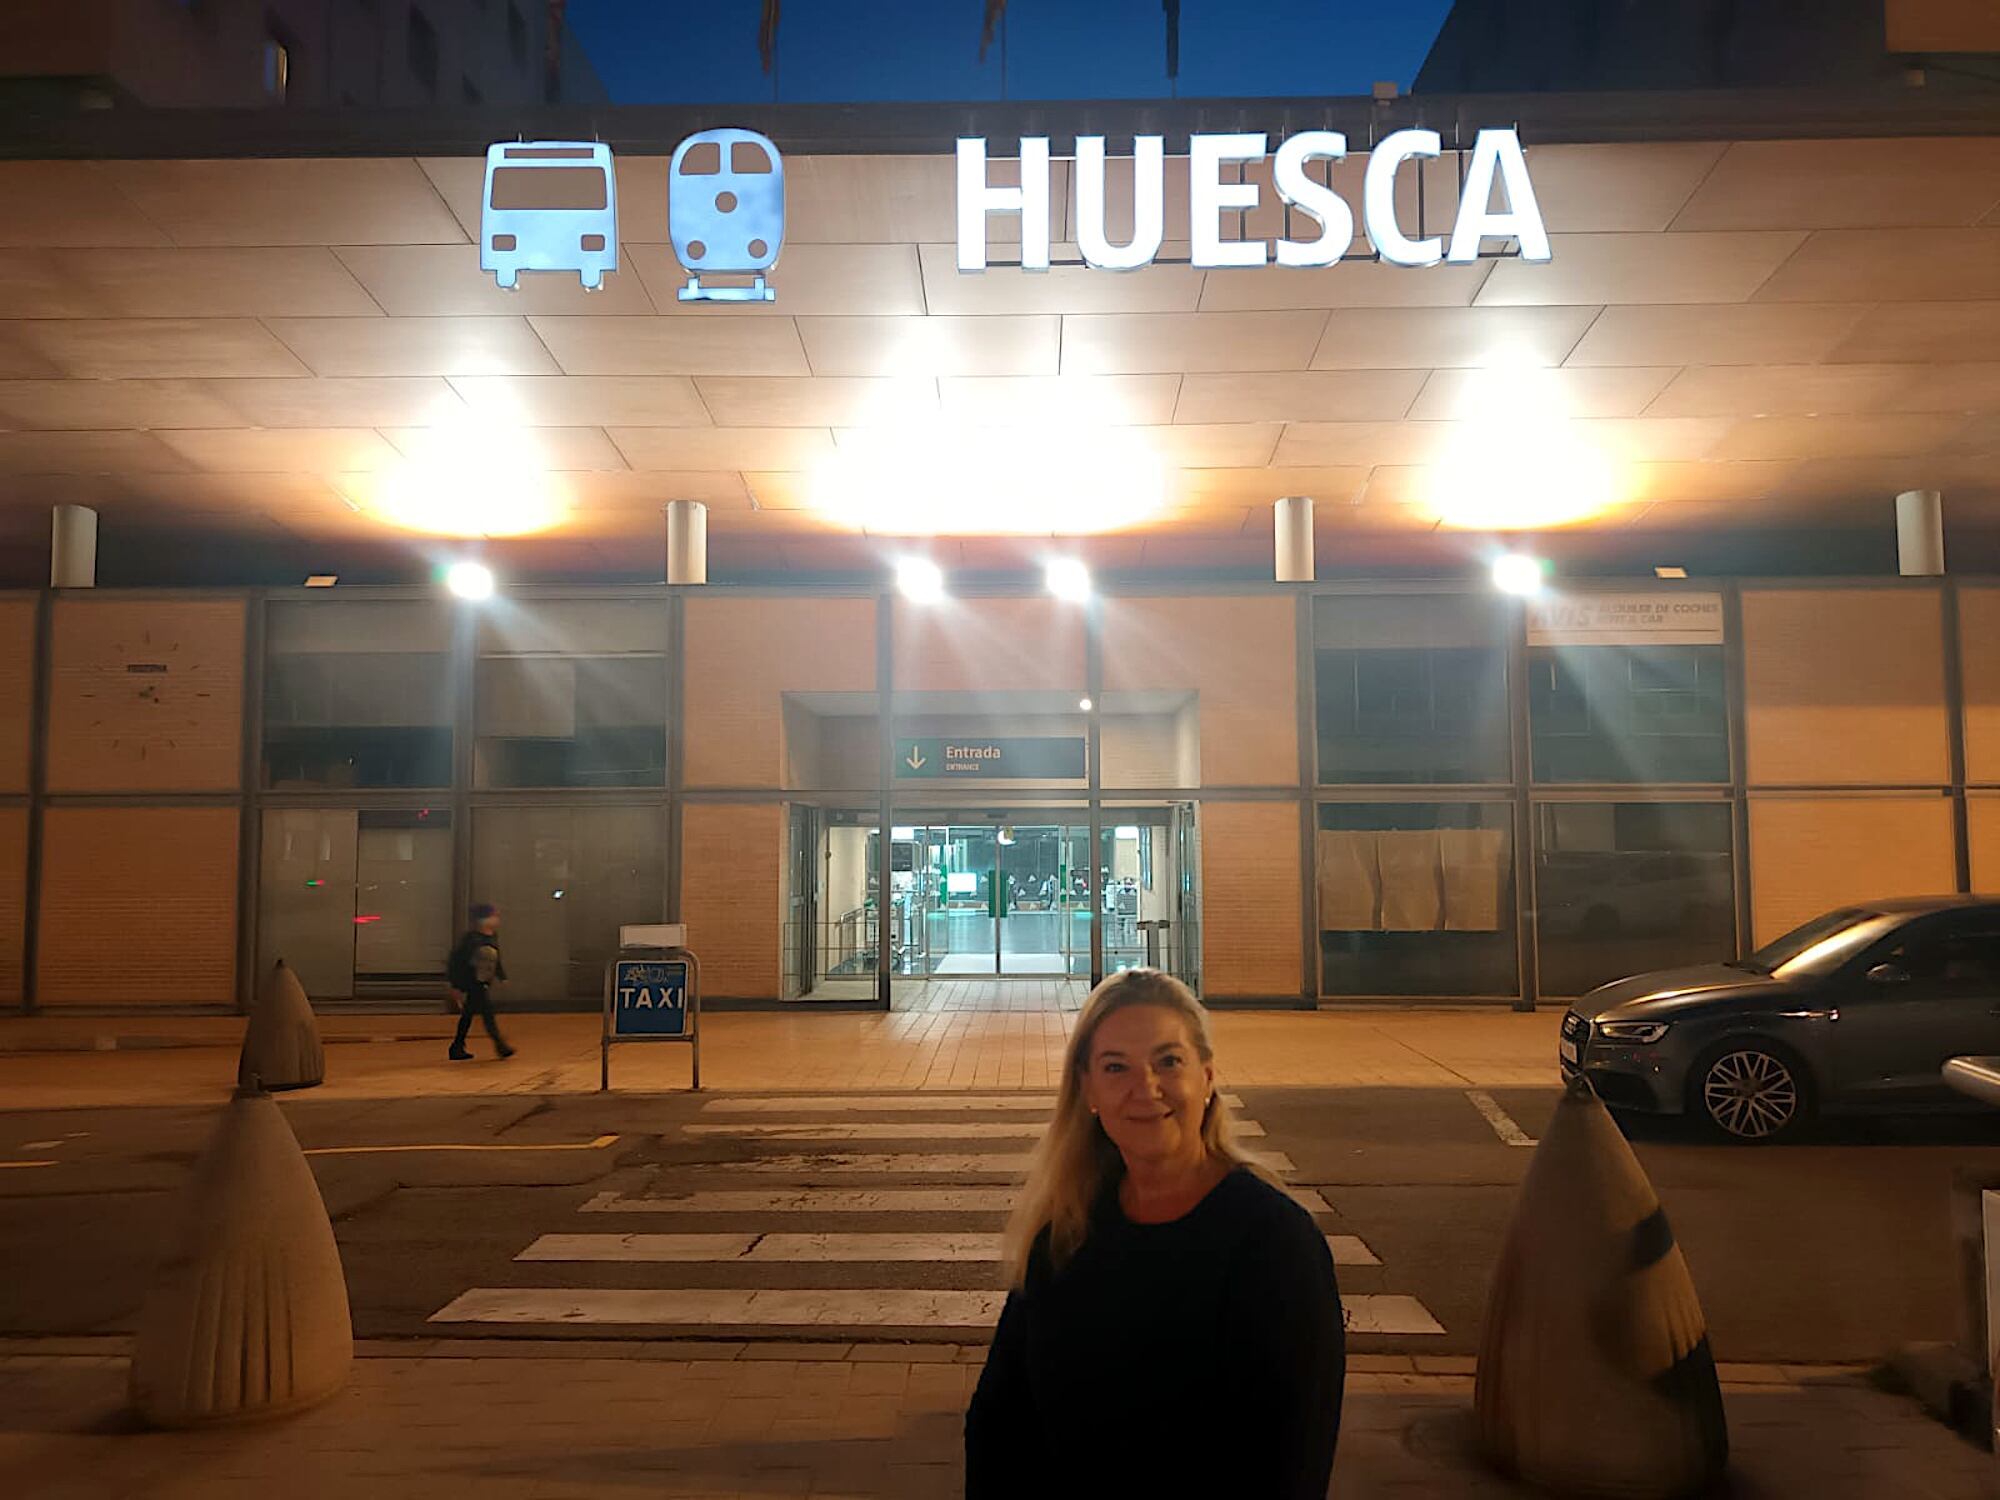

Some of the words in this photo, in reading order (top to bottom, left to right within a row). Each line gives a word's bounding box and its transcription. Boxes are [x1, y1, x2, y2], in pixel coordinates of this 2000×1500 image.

[956, 127, 1552, 271] HUESCA
[945, 745, 1001, 760] Entrada
[619, 986, 684, 1010] TAXI
